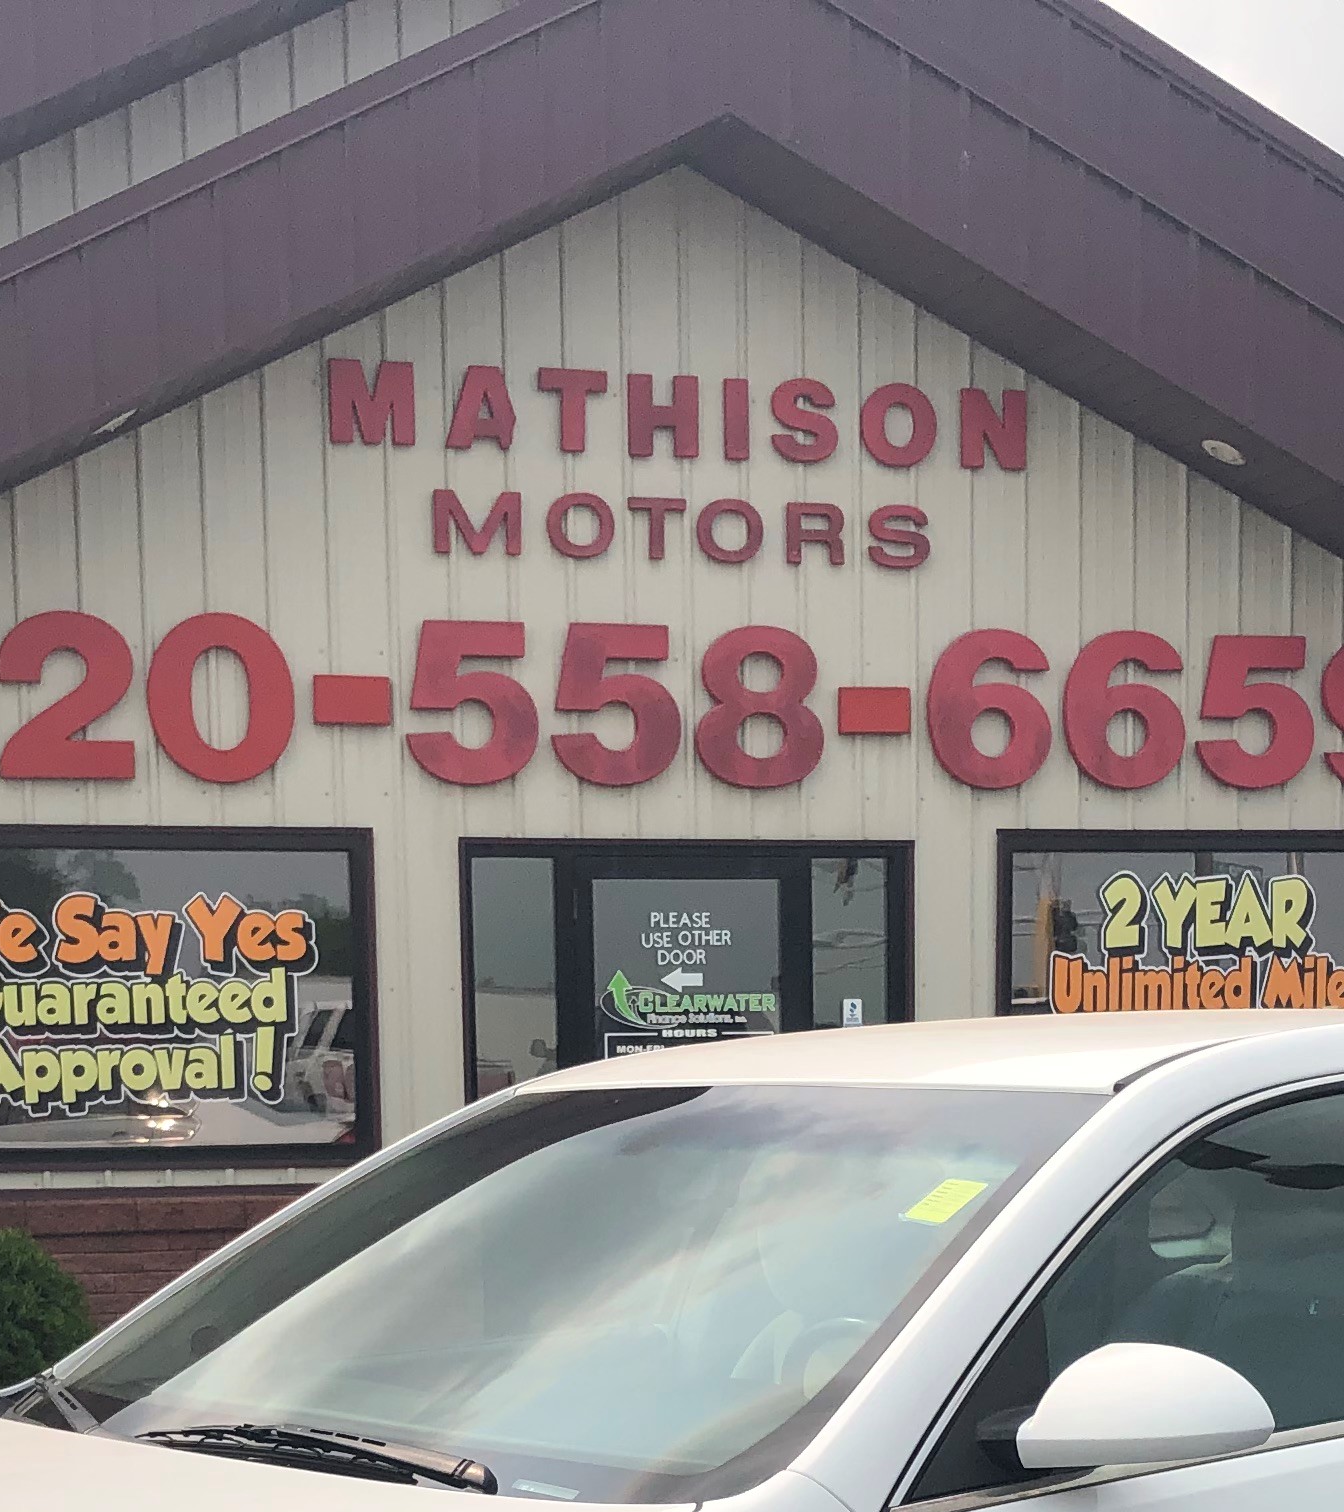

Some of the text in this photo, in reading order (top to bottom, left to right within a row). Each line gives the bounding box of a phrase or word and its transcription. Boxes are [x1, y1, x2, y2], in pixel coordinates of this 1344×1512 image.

[328, 358, 1027, 470] MATHISON
[433, 489, 931, 569] MOTORS
[649, 912, 712, 929] PLEASE
[1102, 872, 1311, 951] 2 YEAR
[55, 894, 179, 975] Say
[185, 892, 313, 965] Yes
[641, 930, 732, 948] USE OTHER
[657, 949, 707, 965] DOOR
[638, 991, 776, 1013] CLEARWATER
[1055, 955, 1255, 1013] Unlimited
[662, 1029, 718, 1039] HOURS
